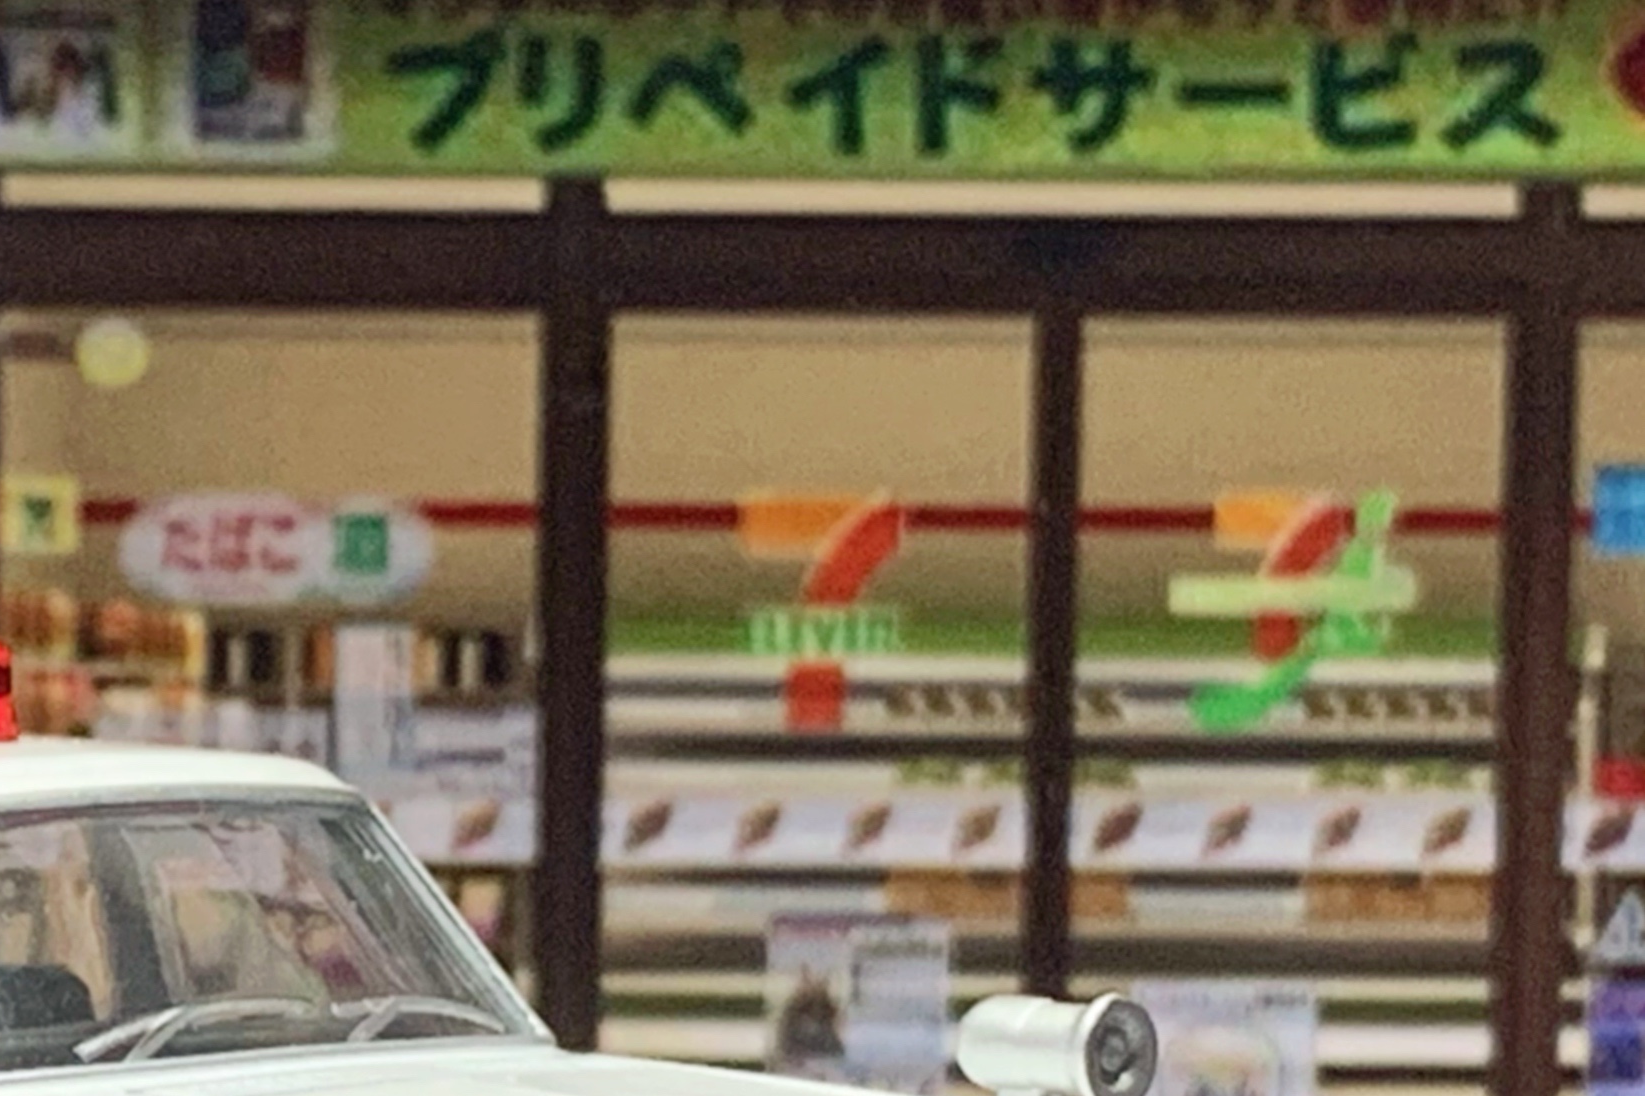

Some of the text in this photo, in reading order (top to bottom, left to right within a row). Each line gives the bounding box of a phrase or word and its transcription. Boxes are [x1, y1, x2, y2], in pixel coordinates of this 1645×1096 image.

[384, 30, 1562, 155] プリペイドサービス
